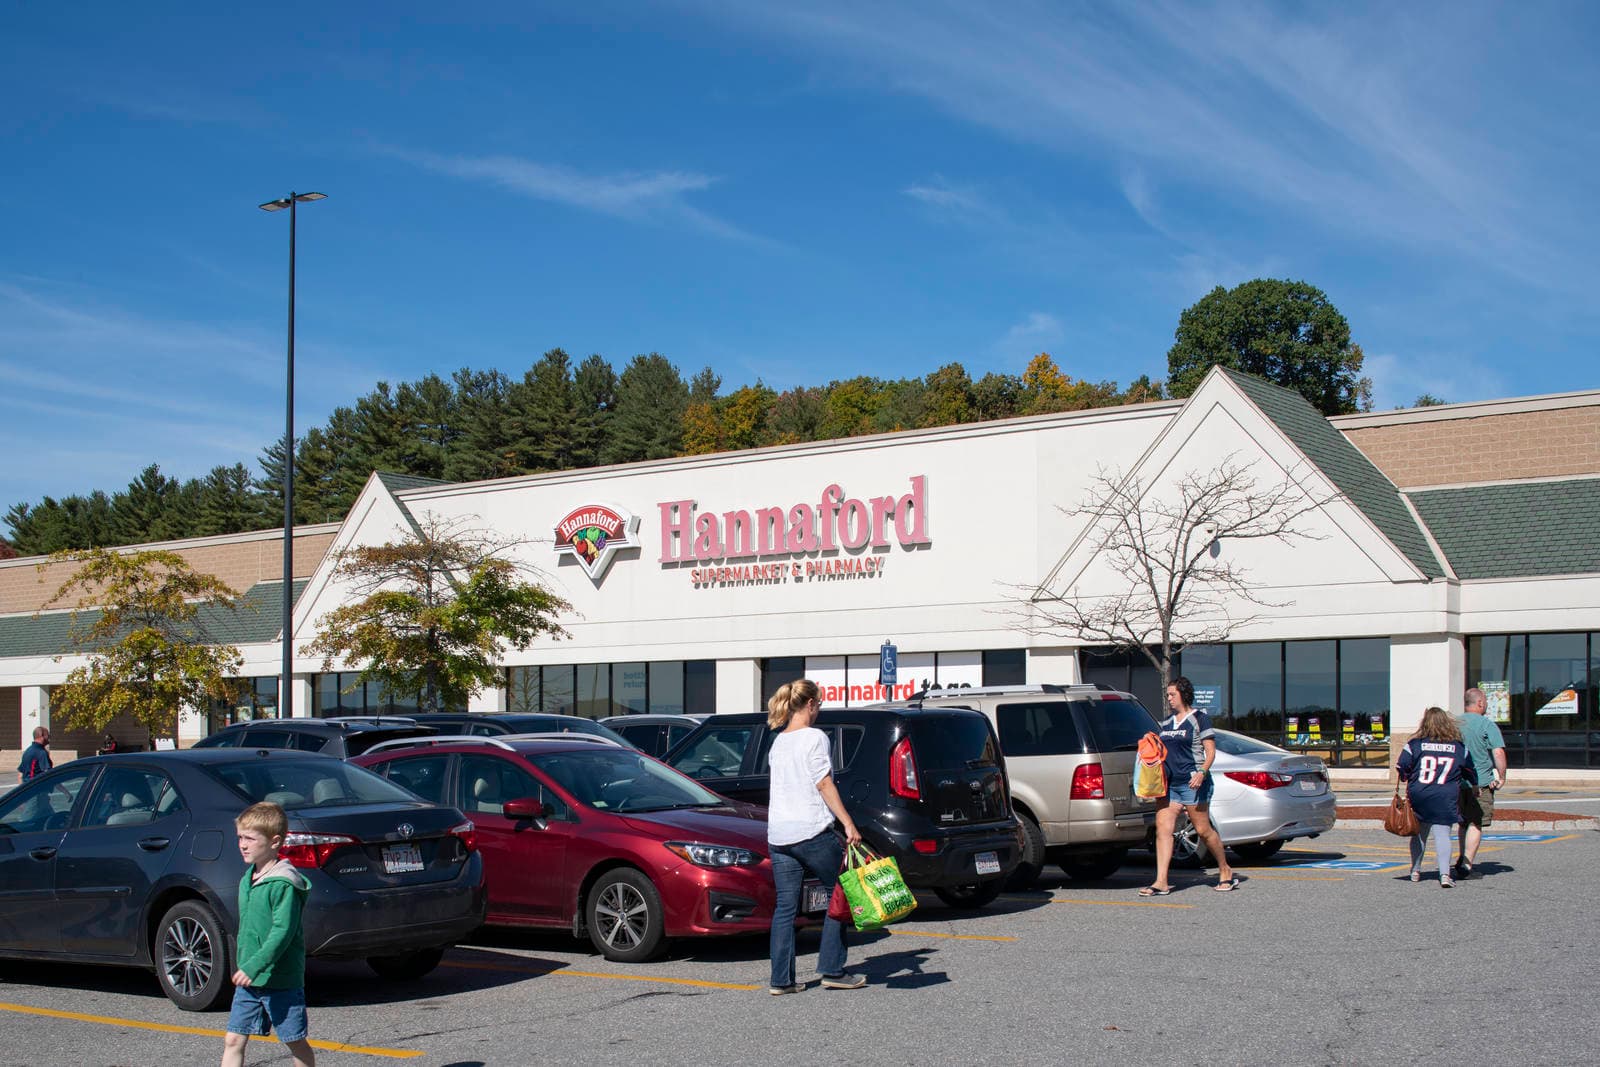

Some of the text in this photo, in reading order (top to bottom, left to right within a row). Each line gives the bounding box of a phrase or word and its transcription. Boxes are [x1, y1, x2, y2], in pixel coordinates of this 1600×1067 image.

[559, 510, 620, 538] Hannaford
[657, 474, 930, 564] Hannaford
[691, 556, 883, 585] SUPERMARKET & PHARMACY
[1418, 755, 1455, 785] 87
